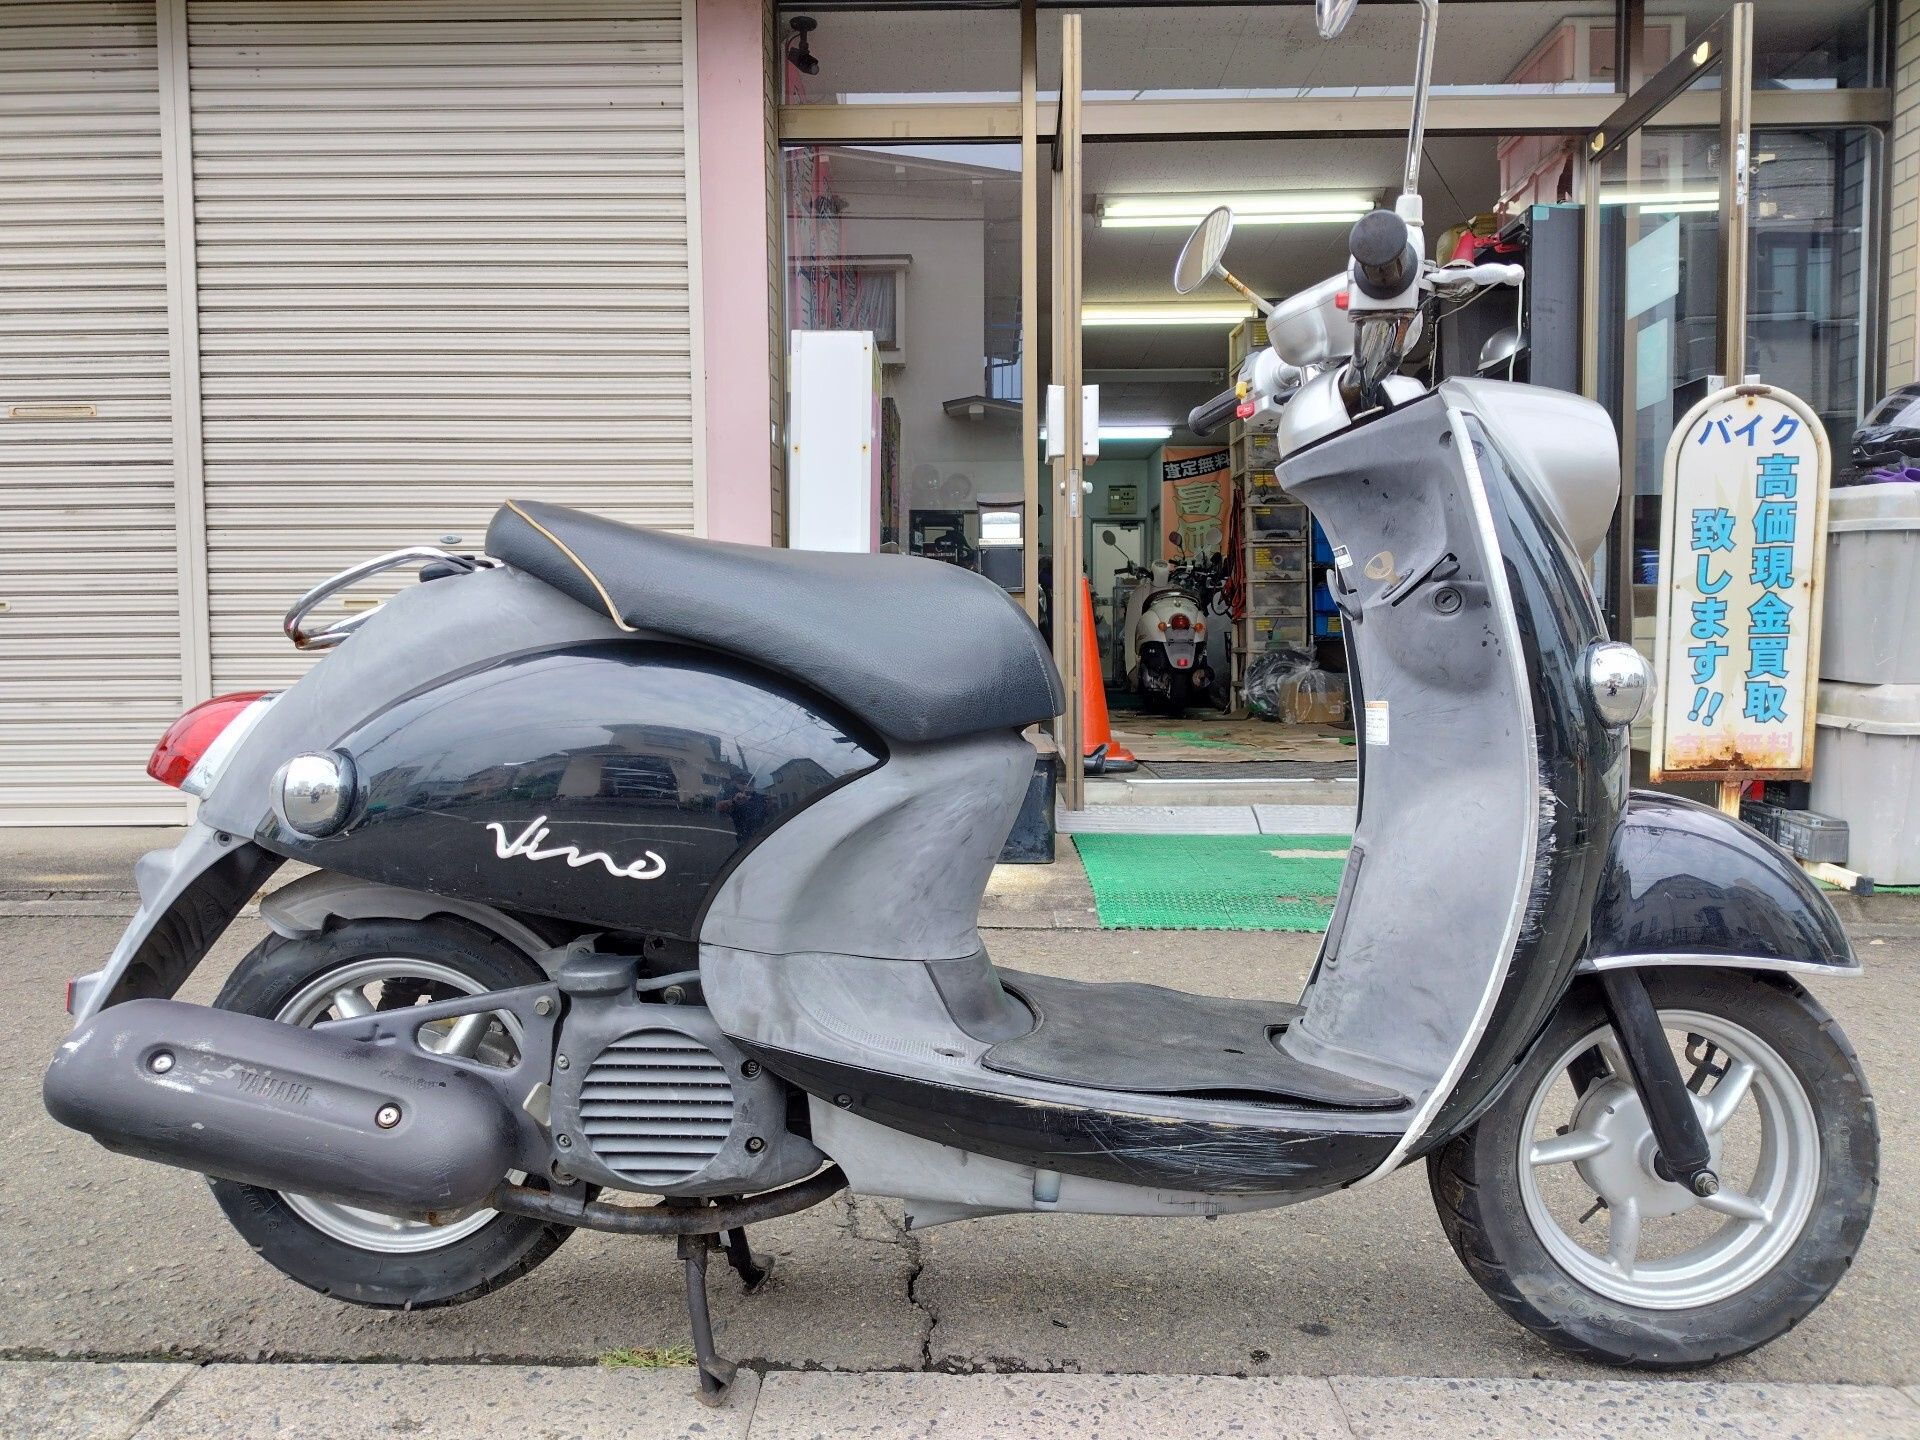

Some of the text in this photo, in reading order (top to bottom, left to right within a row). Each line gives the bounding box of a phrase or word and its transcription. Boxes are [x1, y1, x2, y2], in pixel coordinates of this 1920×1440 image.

[1698, 414, 1800, 446] バイク
[1164, 452, 1230, 479] 査定無料
[1743, 453, 1800, 724] 高価現金買取
[1687, 507, 1737, 727] 致します!!
[486, 815, 667, 880] Vino
[236, 1070, 313, 1106] YAMAHA
[1549, 1284, 1639, 1336] D306
